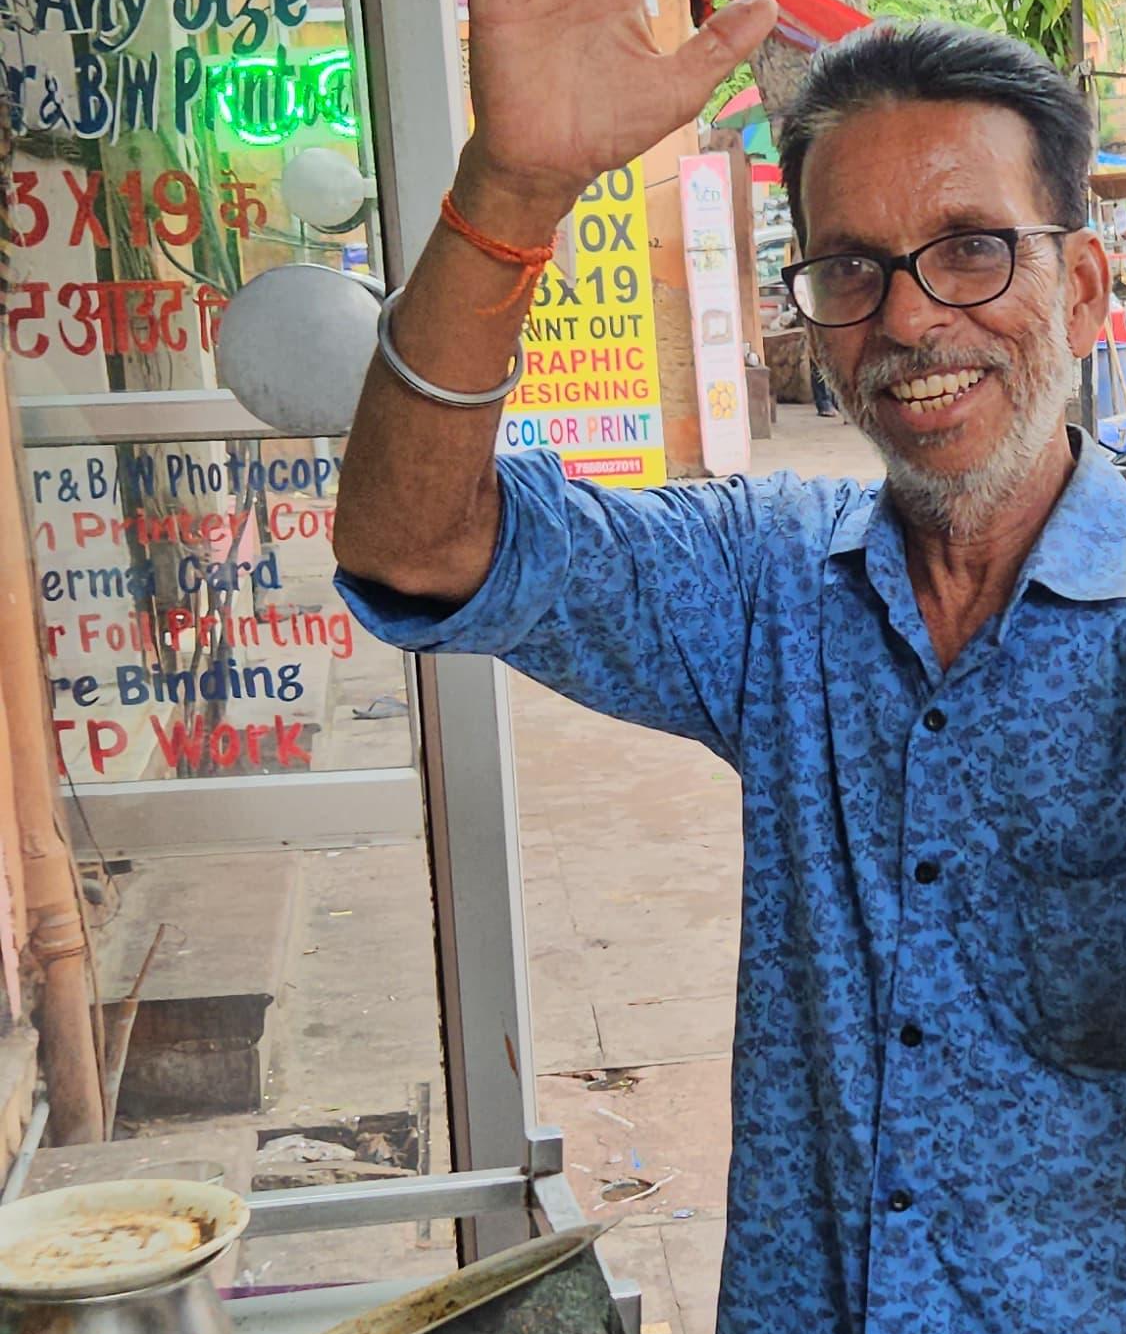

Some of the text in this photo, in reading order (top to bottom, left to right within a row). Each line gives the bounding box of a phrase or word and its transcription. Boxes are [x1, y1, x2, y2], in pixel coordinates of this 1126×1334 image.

[576, 213, 636, 253] OX
[589, 314, 643, 340] OUT
[526, 346, 645, 376] RAPHIC
[505, 413, 651, 447] COLOR PRINT
[57, 468, 81, 503] &
[86, 453, 154, 505] B/W
[72, 506, 250, 548] Printer
[178, 551, 283, 594] Card
[78, 610, 153, 654] Foil
[166, 603, 354, 660] Printing
[116, 659, 304, 707] Binding
[149, 714, 312, 769] Work
